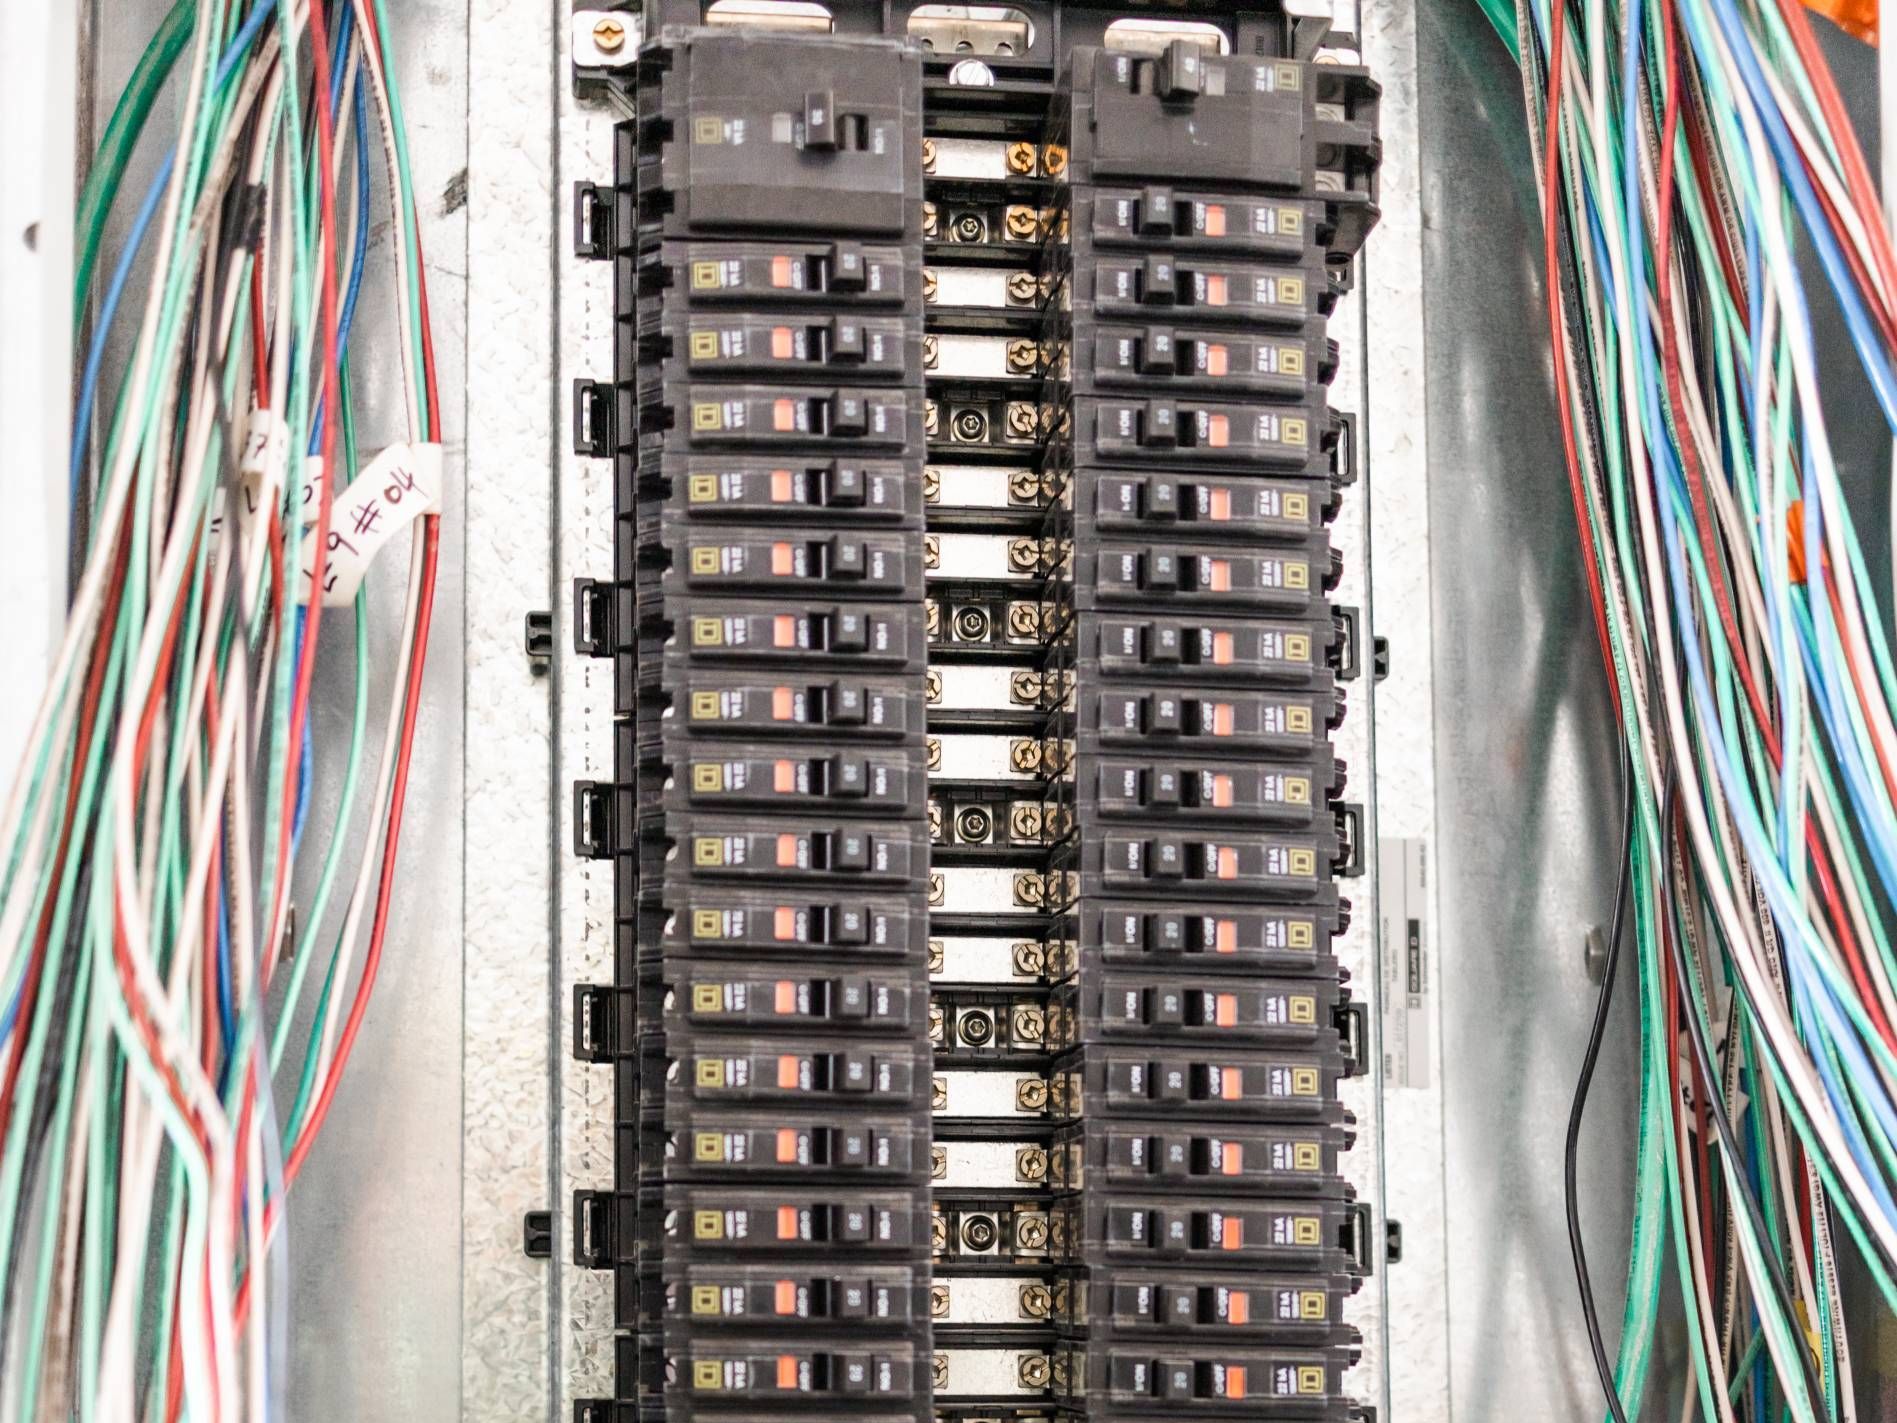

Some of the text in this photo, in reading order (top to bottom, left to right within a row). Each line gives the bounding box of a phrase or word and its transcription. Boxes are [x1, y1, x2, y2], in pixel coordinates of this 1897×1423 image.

[1162, 845, 1175, 861] 20
[845, 913, 858, 930] 20
[1165, 922, 1178, 938] 20
[1409, 952, 1420, 992] SQUARE
[846, 987, 859, 1004] 20
[1164, 995, 1177, 1012] 20
[849, 1062, 862, 1080] 20
[1169, 1072, 1181, 1088] 20
[847, 1137, 860, 1154] 20
[1170, 1145, 1183, 1162] 20
[849, 1213, 862, 1230] 20
[1171, 1221, 1184, 1238] 20
[847, 1289, 860, 1306] 20
[1175, 1297, 1188, 1314] 20
[849, 1364, 862, 1382] 20
[1174, 1372, 1187, 1389] 20
